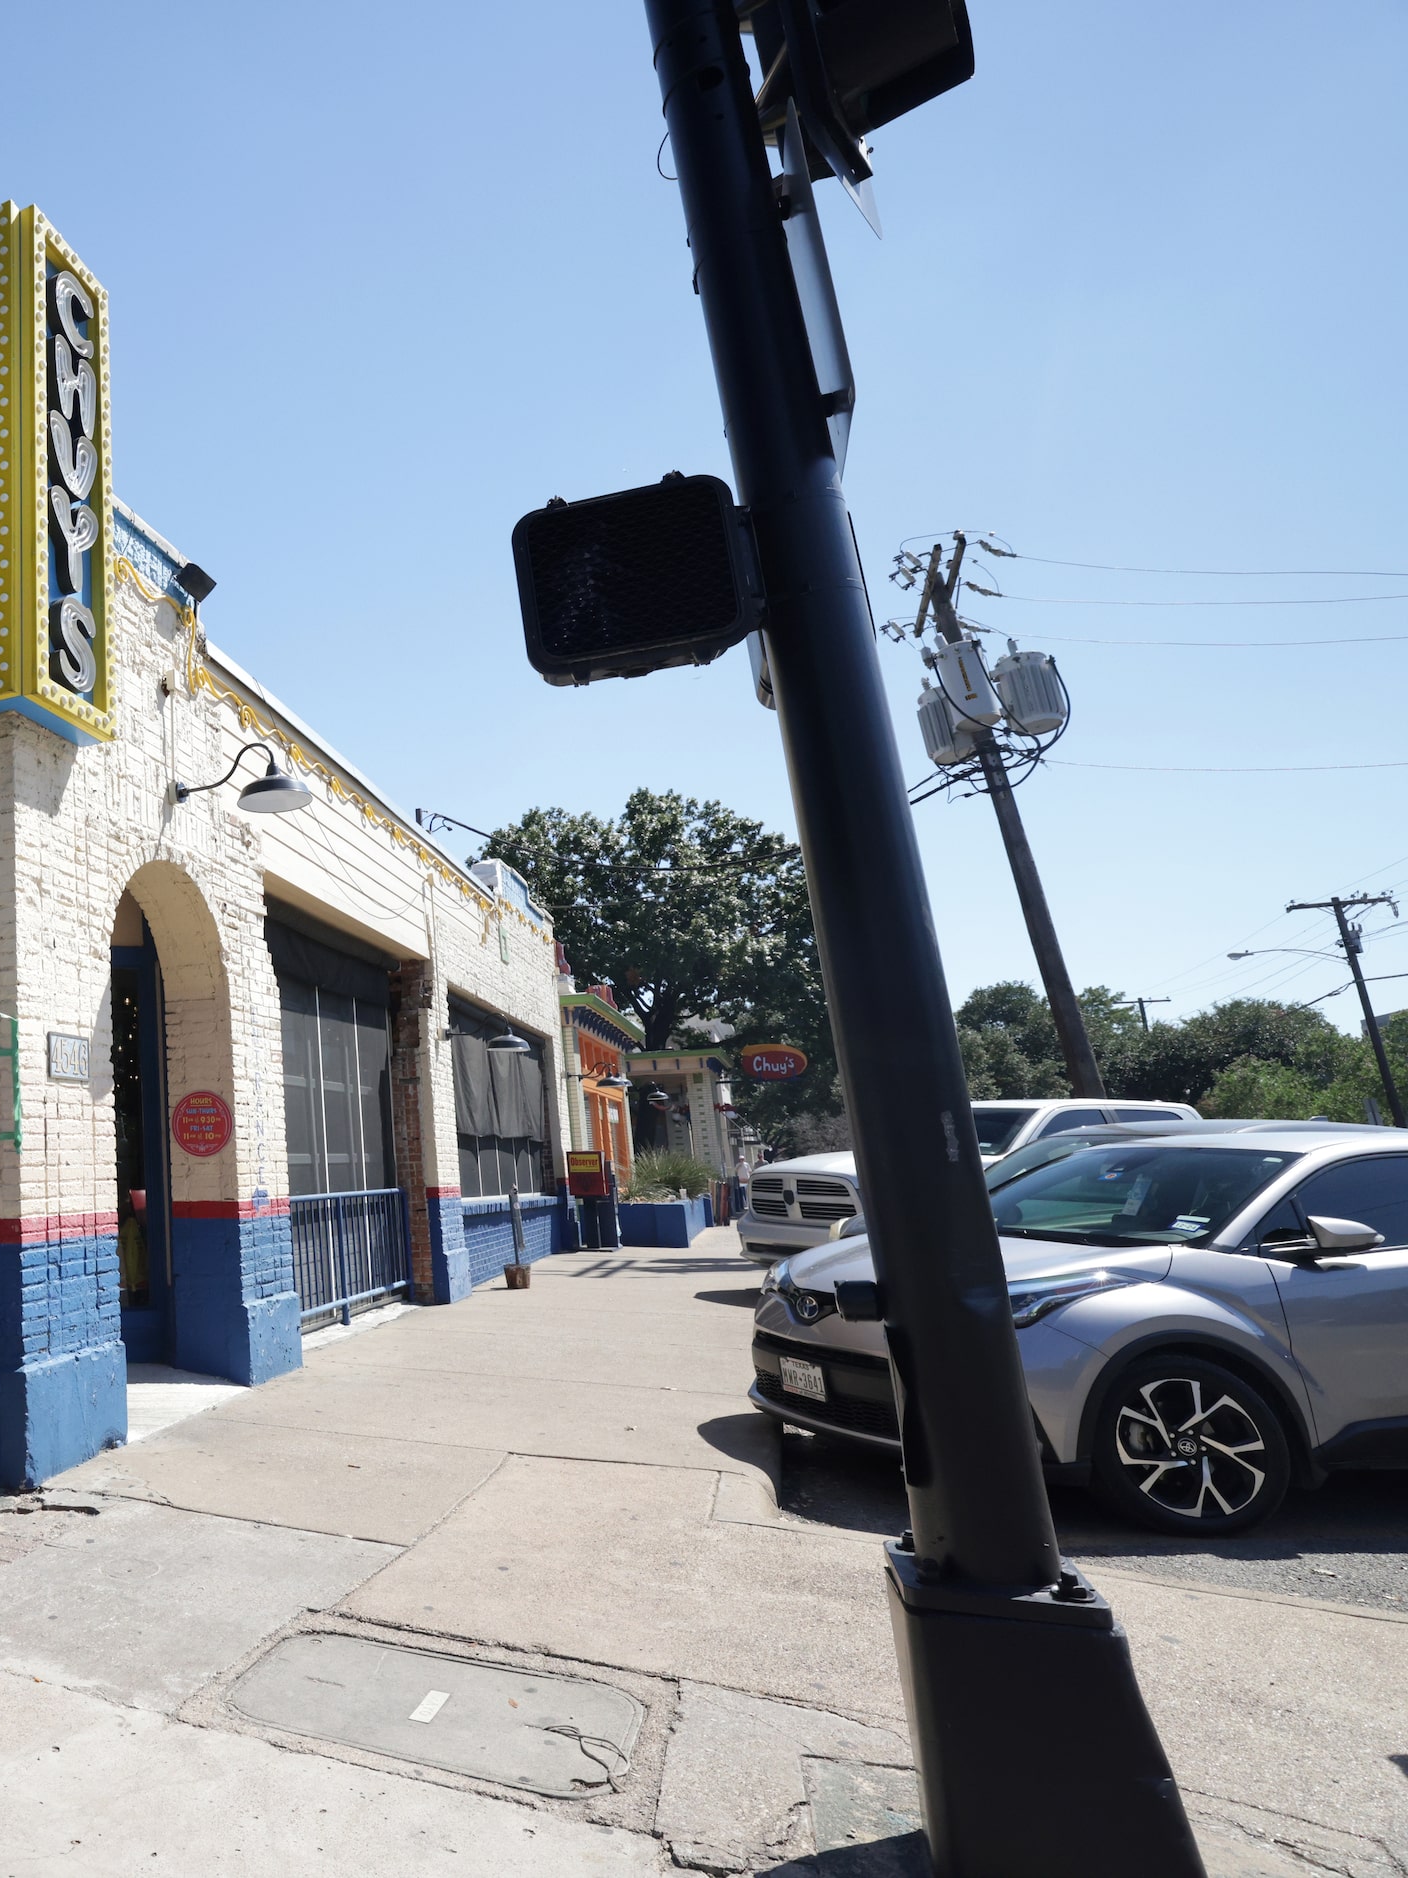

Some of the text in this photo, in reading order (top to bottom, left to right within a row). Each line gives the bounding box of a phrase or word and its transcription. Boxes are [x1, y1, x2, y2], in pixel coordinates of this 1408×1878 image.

[47, 269, 100, 694] CHUYS
[51, 1037, 88, 1076] 4546
[753, 1055, 795, 1075] Chuy's
[190, 1097, 213, 1105] HOURS
[570, 1157, 598, 1167] Observer
